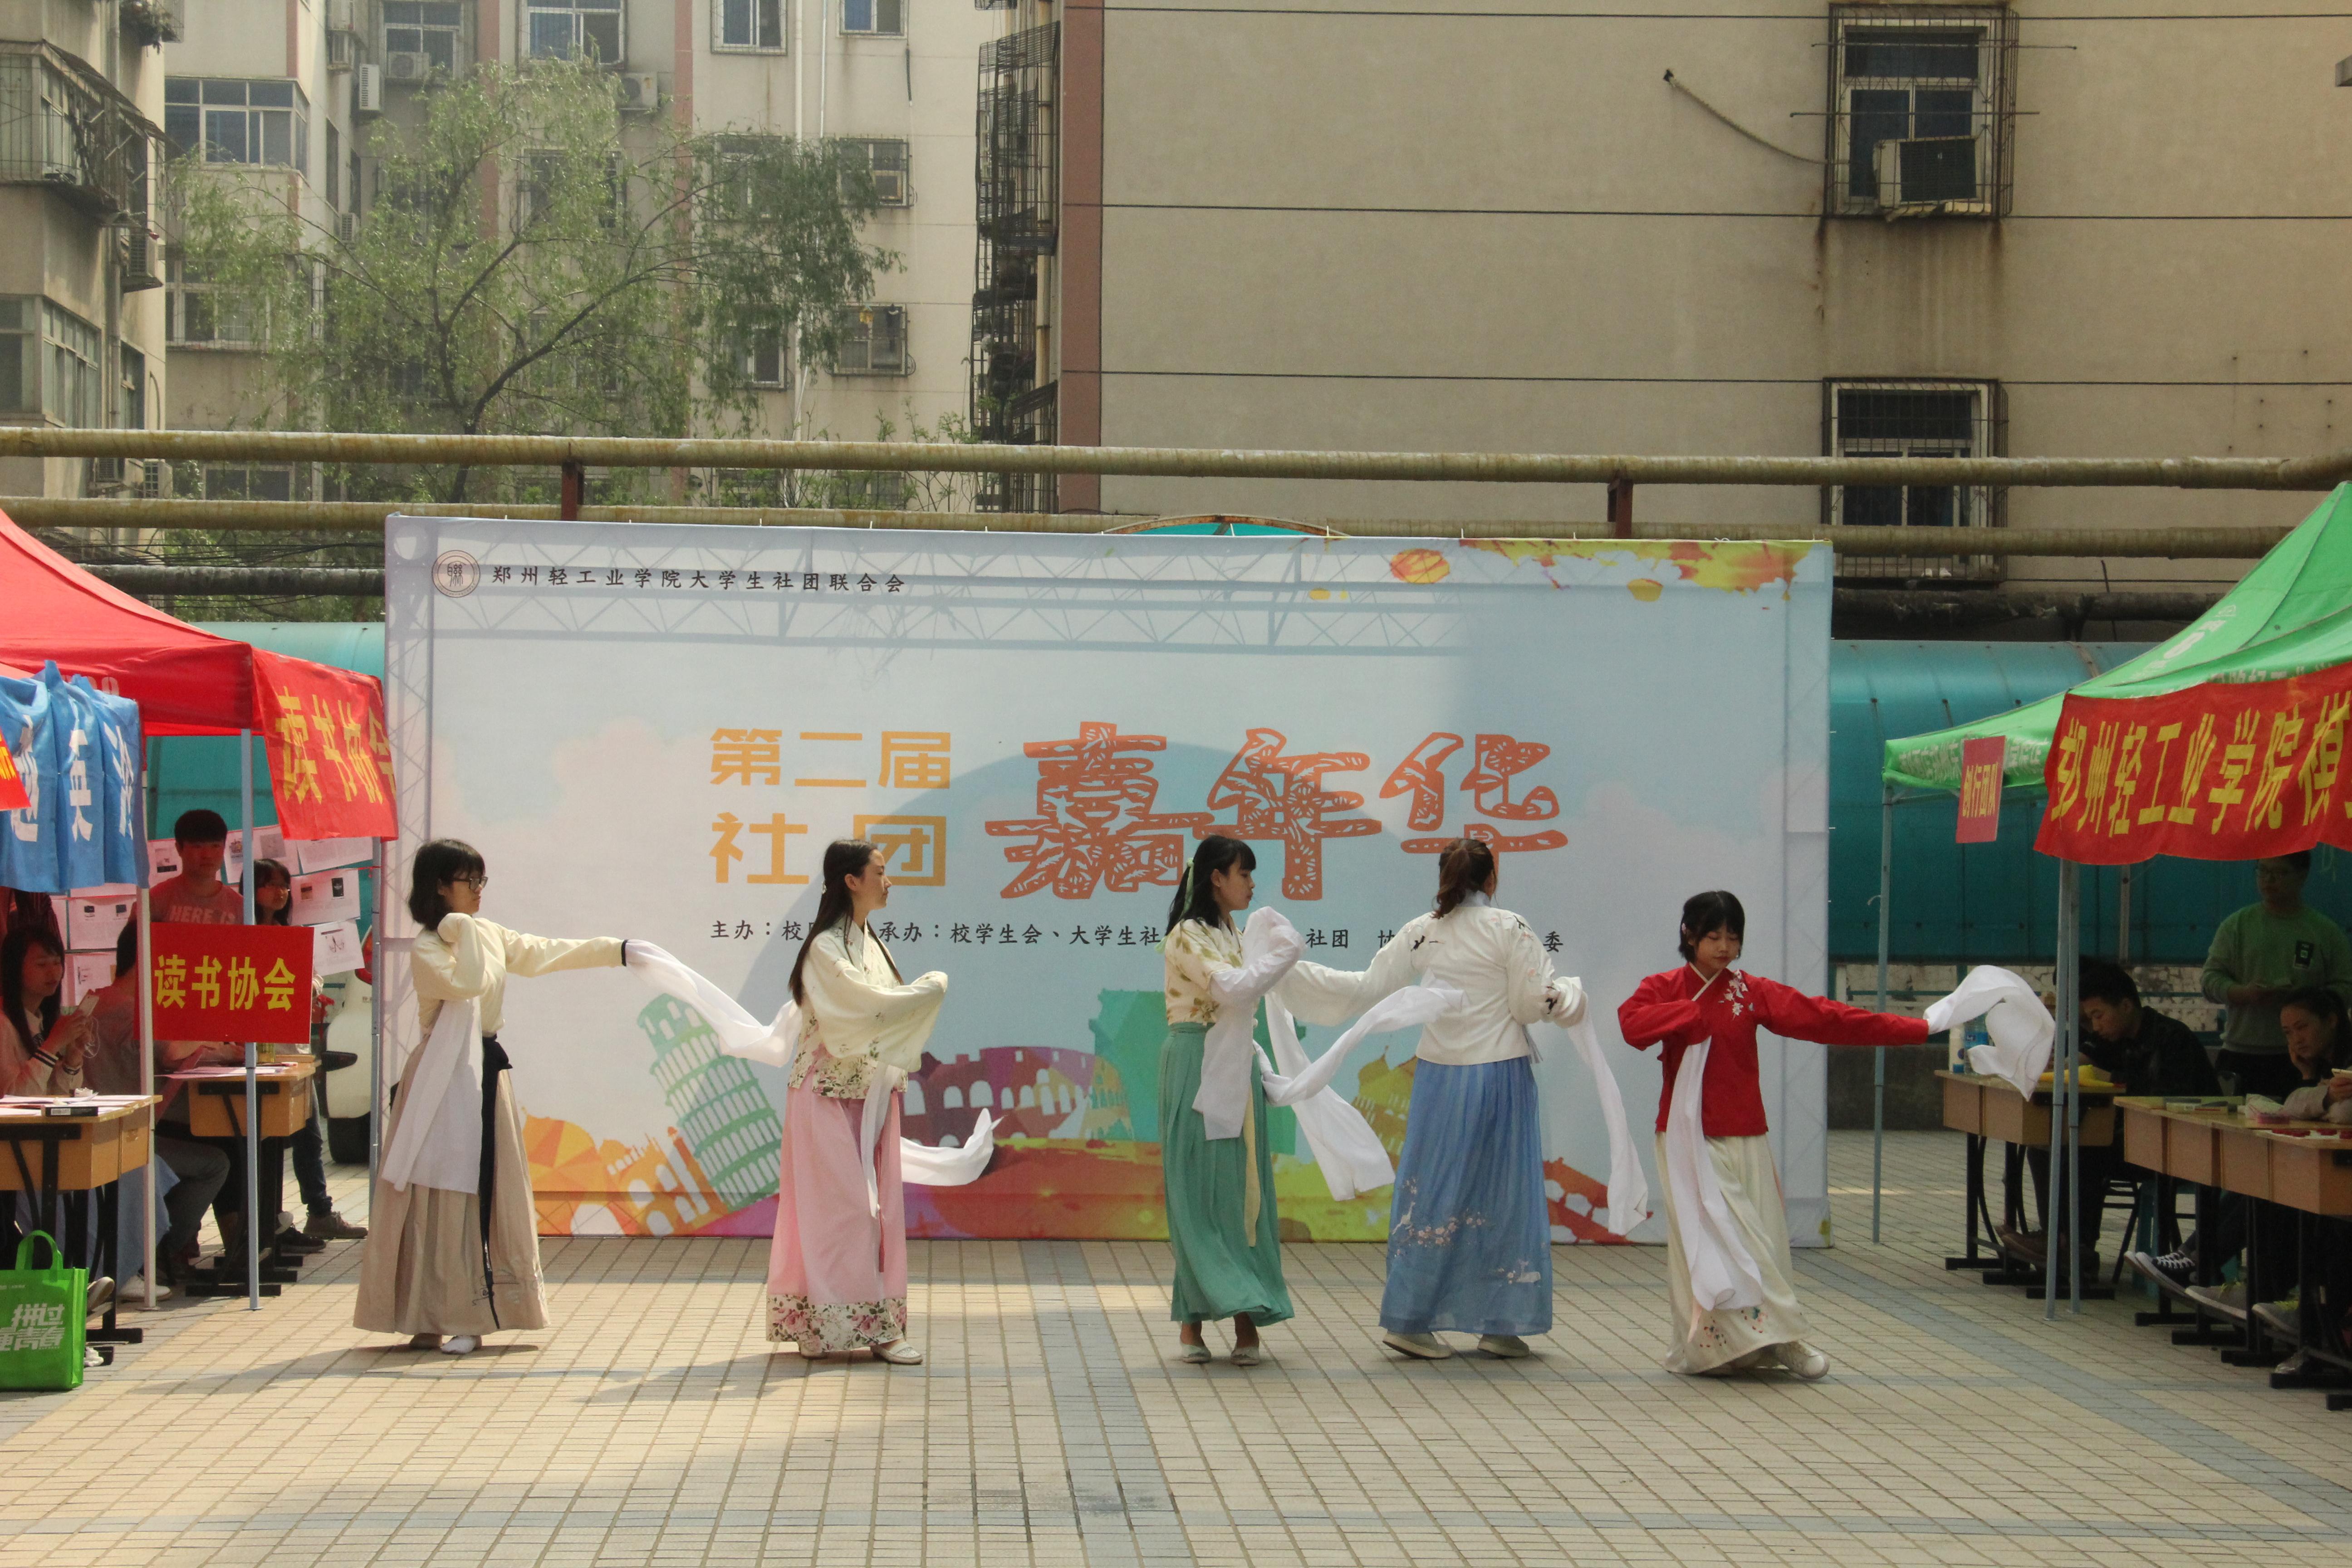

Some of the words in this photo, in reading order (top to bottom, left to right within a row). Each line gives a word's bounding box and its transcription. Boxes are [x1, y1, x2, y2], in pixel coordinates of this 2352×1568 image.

[492, 566, 905, 593] 郑州轻工业学院大学生社团联合会
[275, 686, 397, 804] 读书协会
[710, 728, 951, 789] 第二届
[985, 721, 1568, 901] 嘉年华
[709, 812, 946, 887] 社团
[169, 906, 215, 924] HERE
[710, 920, 816, 941] 主办：校
[154, 954, 296, 1012] 读书协会
